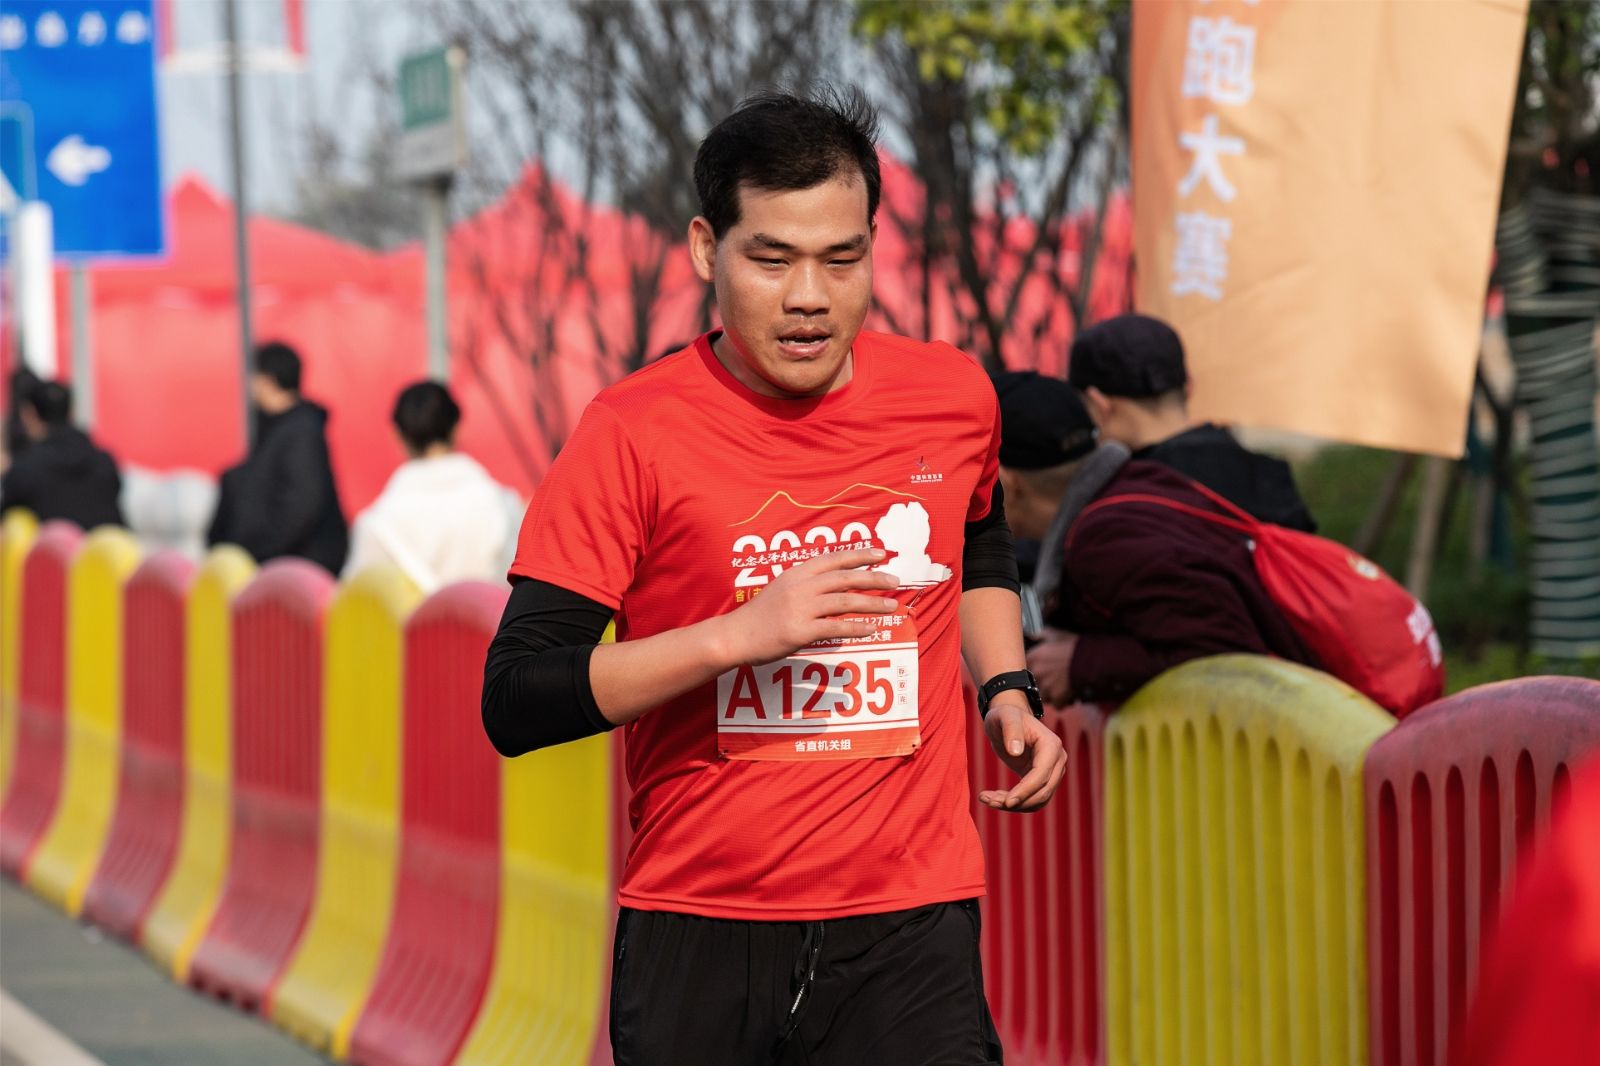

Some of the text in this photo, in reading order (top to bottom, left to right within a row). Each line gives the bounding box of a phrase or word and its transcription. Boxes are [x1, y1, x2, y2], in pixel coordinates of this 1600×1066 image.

[1170, 0, 1259, 302] 跑大赛
[724, 658, 895, 721] A1235
[794, 738, 852, 753] 省直机关组
